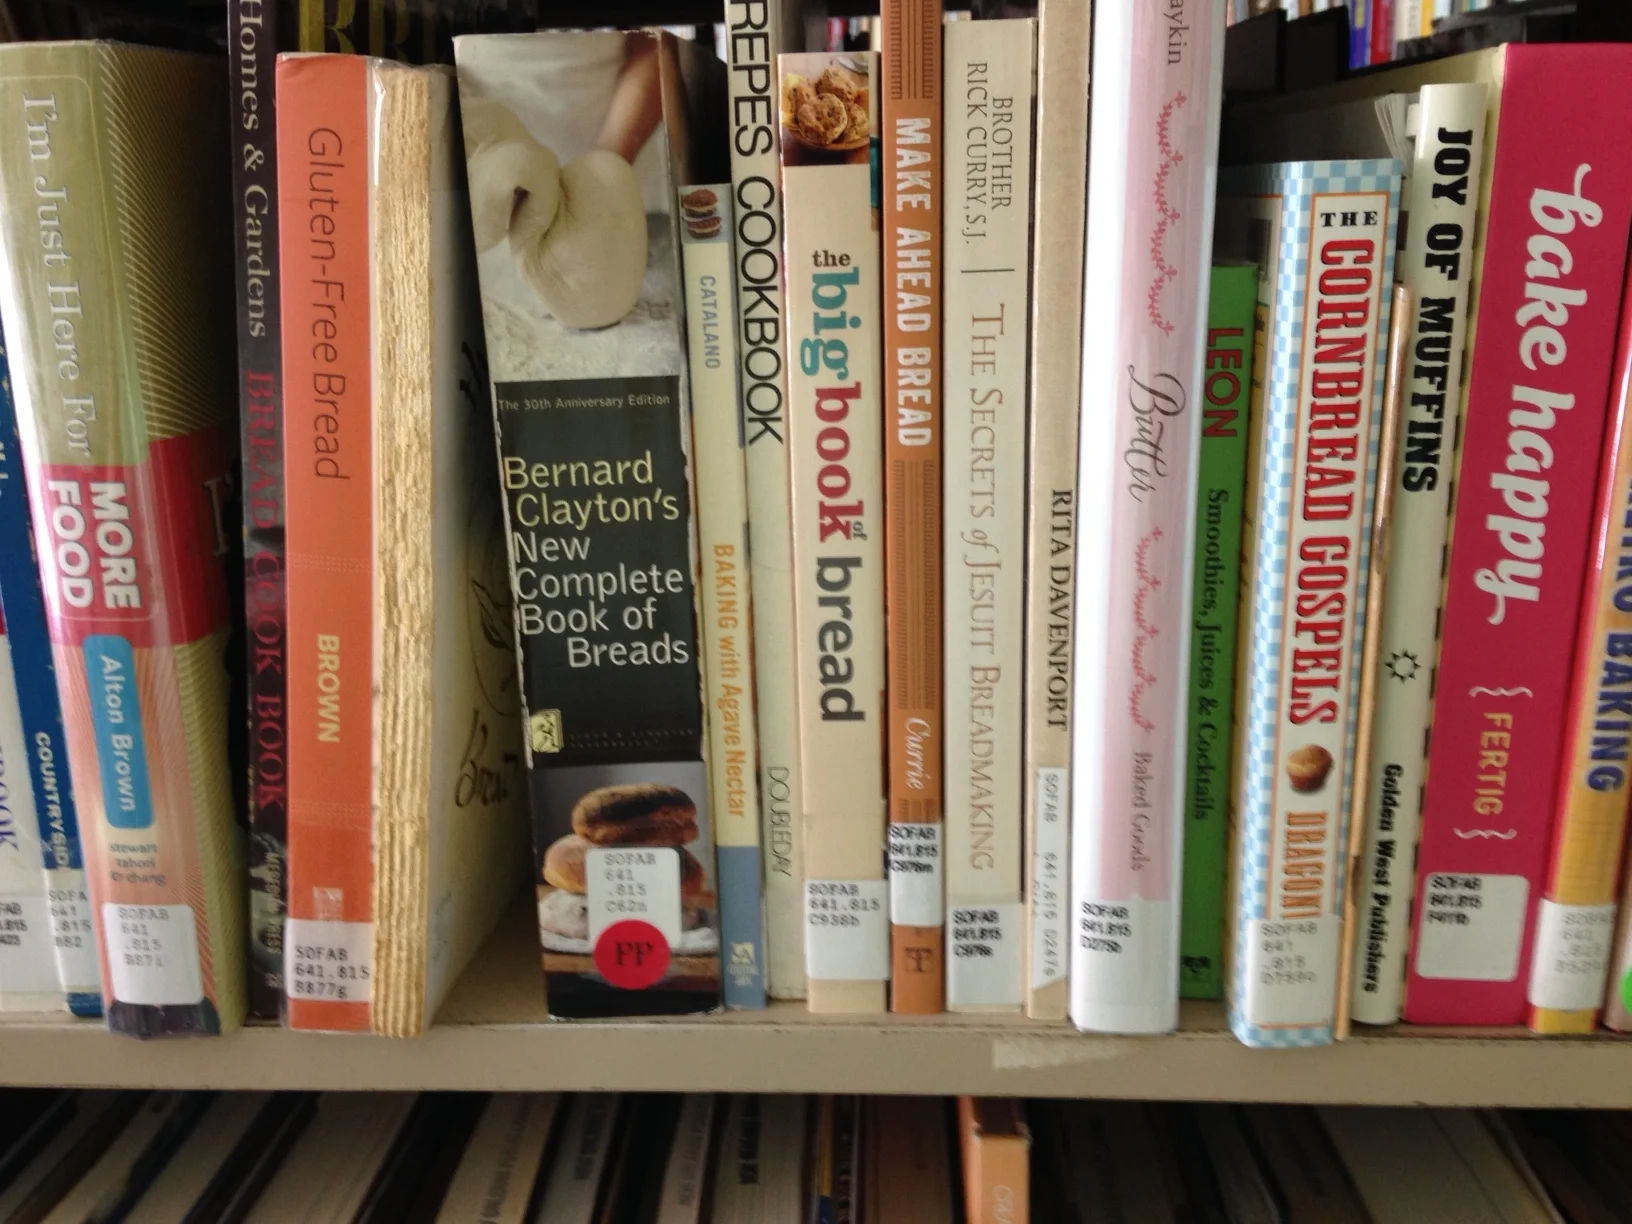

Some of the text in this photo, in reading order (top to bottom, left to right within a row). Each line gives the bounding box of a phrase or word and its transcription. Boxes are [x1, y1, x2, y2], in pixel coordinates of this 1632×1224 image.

[967, 62, 988, 118] RICK
[992, 97, 1013, 211] BROTHER
[812, 250, 851, 267] the
[1320, 211, 1378, 227] THE
[22, 93, 98, 456] I'm Just Here For
[308, 127, 350, 480] Gluten-Free Bread
[700, 275, 721, 370] CATALANO
[737, 176, 783, 446] COOKBOOK
[801, 267, 861, 380] big
[896, 118, 931, 446] MAKE AHEAD BREAD
[1402, 127, 1473, 492] JOY OF MUFFINS
[238, 0, 285, 810] Homes & Gardens BREAD COOK BOOK
[499, 393, 670, 411] The 30th Anniversary Edition
[1203, 327, 1244, 438] LEON
[1473, 163, 1603, 625] bake happy
[504, 450, 654, 489] Bernard
[814, 382, 867, 543] book of
[1124, 363, 1187, 503] Butter
[1289, 239, 1375, 725] CORNBREAD GOSPELS
[48, 479, 95, 608] FOOD
[89, 482, 142, 611] MORE
[513, 531, 591, 563] New
[516, 488, 680, 531] Clayton's
[960, 531, 987, 554] of
[515, 563, 684, 602] Complete
[519, 598, 657, 636] Book of
[1048, 489, 1073, 732] RITA DAVENPORT
[318, 634, 340, 743] BROWN
[567, 632, 690, 668] Breads
[713, 544, 746, 817] BAKING with Agave Nectar
[816, 556, 866, 722] bread
[1193, 489, 1229, 821] Smoothies, Juices & Cocktails
[99, 654, 136, 811] Alton Brown
[905, 717, 931, 789] Currie
[1587, 632, 1632, 792] BAKING
[35, 732, 70, 869] COUNTRYSID
[970, 665, 1002, 870] BREADMAKING
[1043, 773, 1060, 822] SOFAB
[1130, 751, 1155, 872] Baked Goods
[1473, 712, 1514, 815] FERTIG
[110, 842, 158, 853] stewart
[116, 857, 156, 869] tabori
[604, 852, 656, 865] SOFAB
[767, 767, 792, 878] DOUBLEDAY
[890, 826, 936, 839] SOFAB
[119, 907, 169, 920] SOFAB
[127, 872, 166, 886] chang
[605, 868, 634, 881] 641
[808, 883, 860, 896] SOFAB
[808, 898, 880, 911] 641.815
[952, 910, 999, 924] SOFAB
[1082, 902, 1129, 918] SOFAB
[1362, 763, 1404, 994] Golden West Publishers
[122, 922, 148, 935] 641
[295, 945, 348, 961] SOFAB
[295, 963, 370, 980] 641.815
